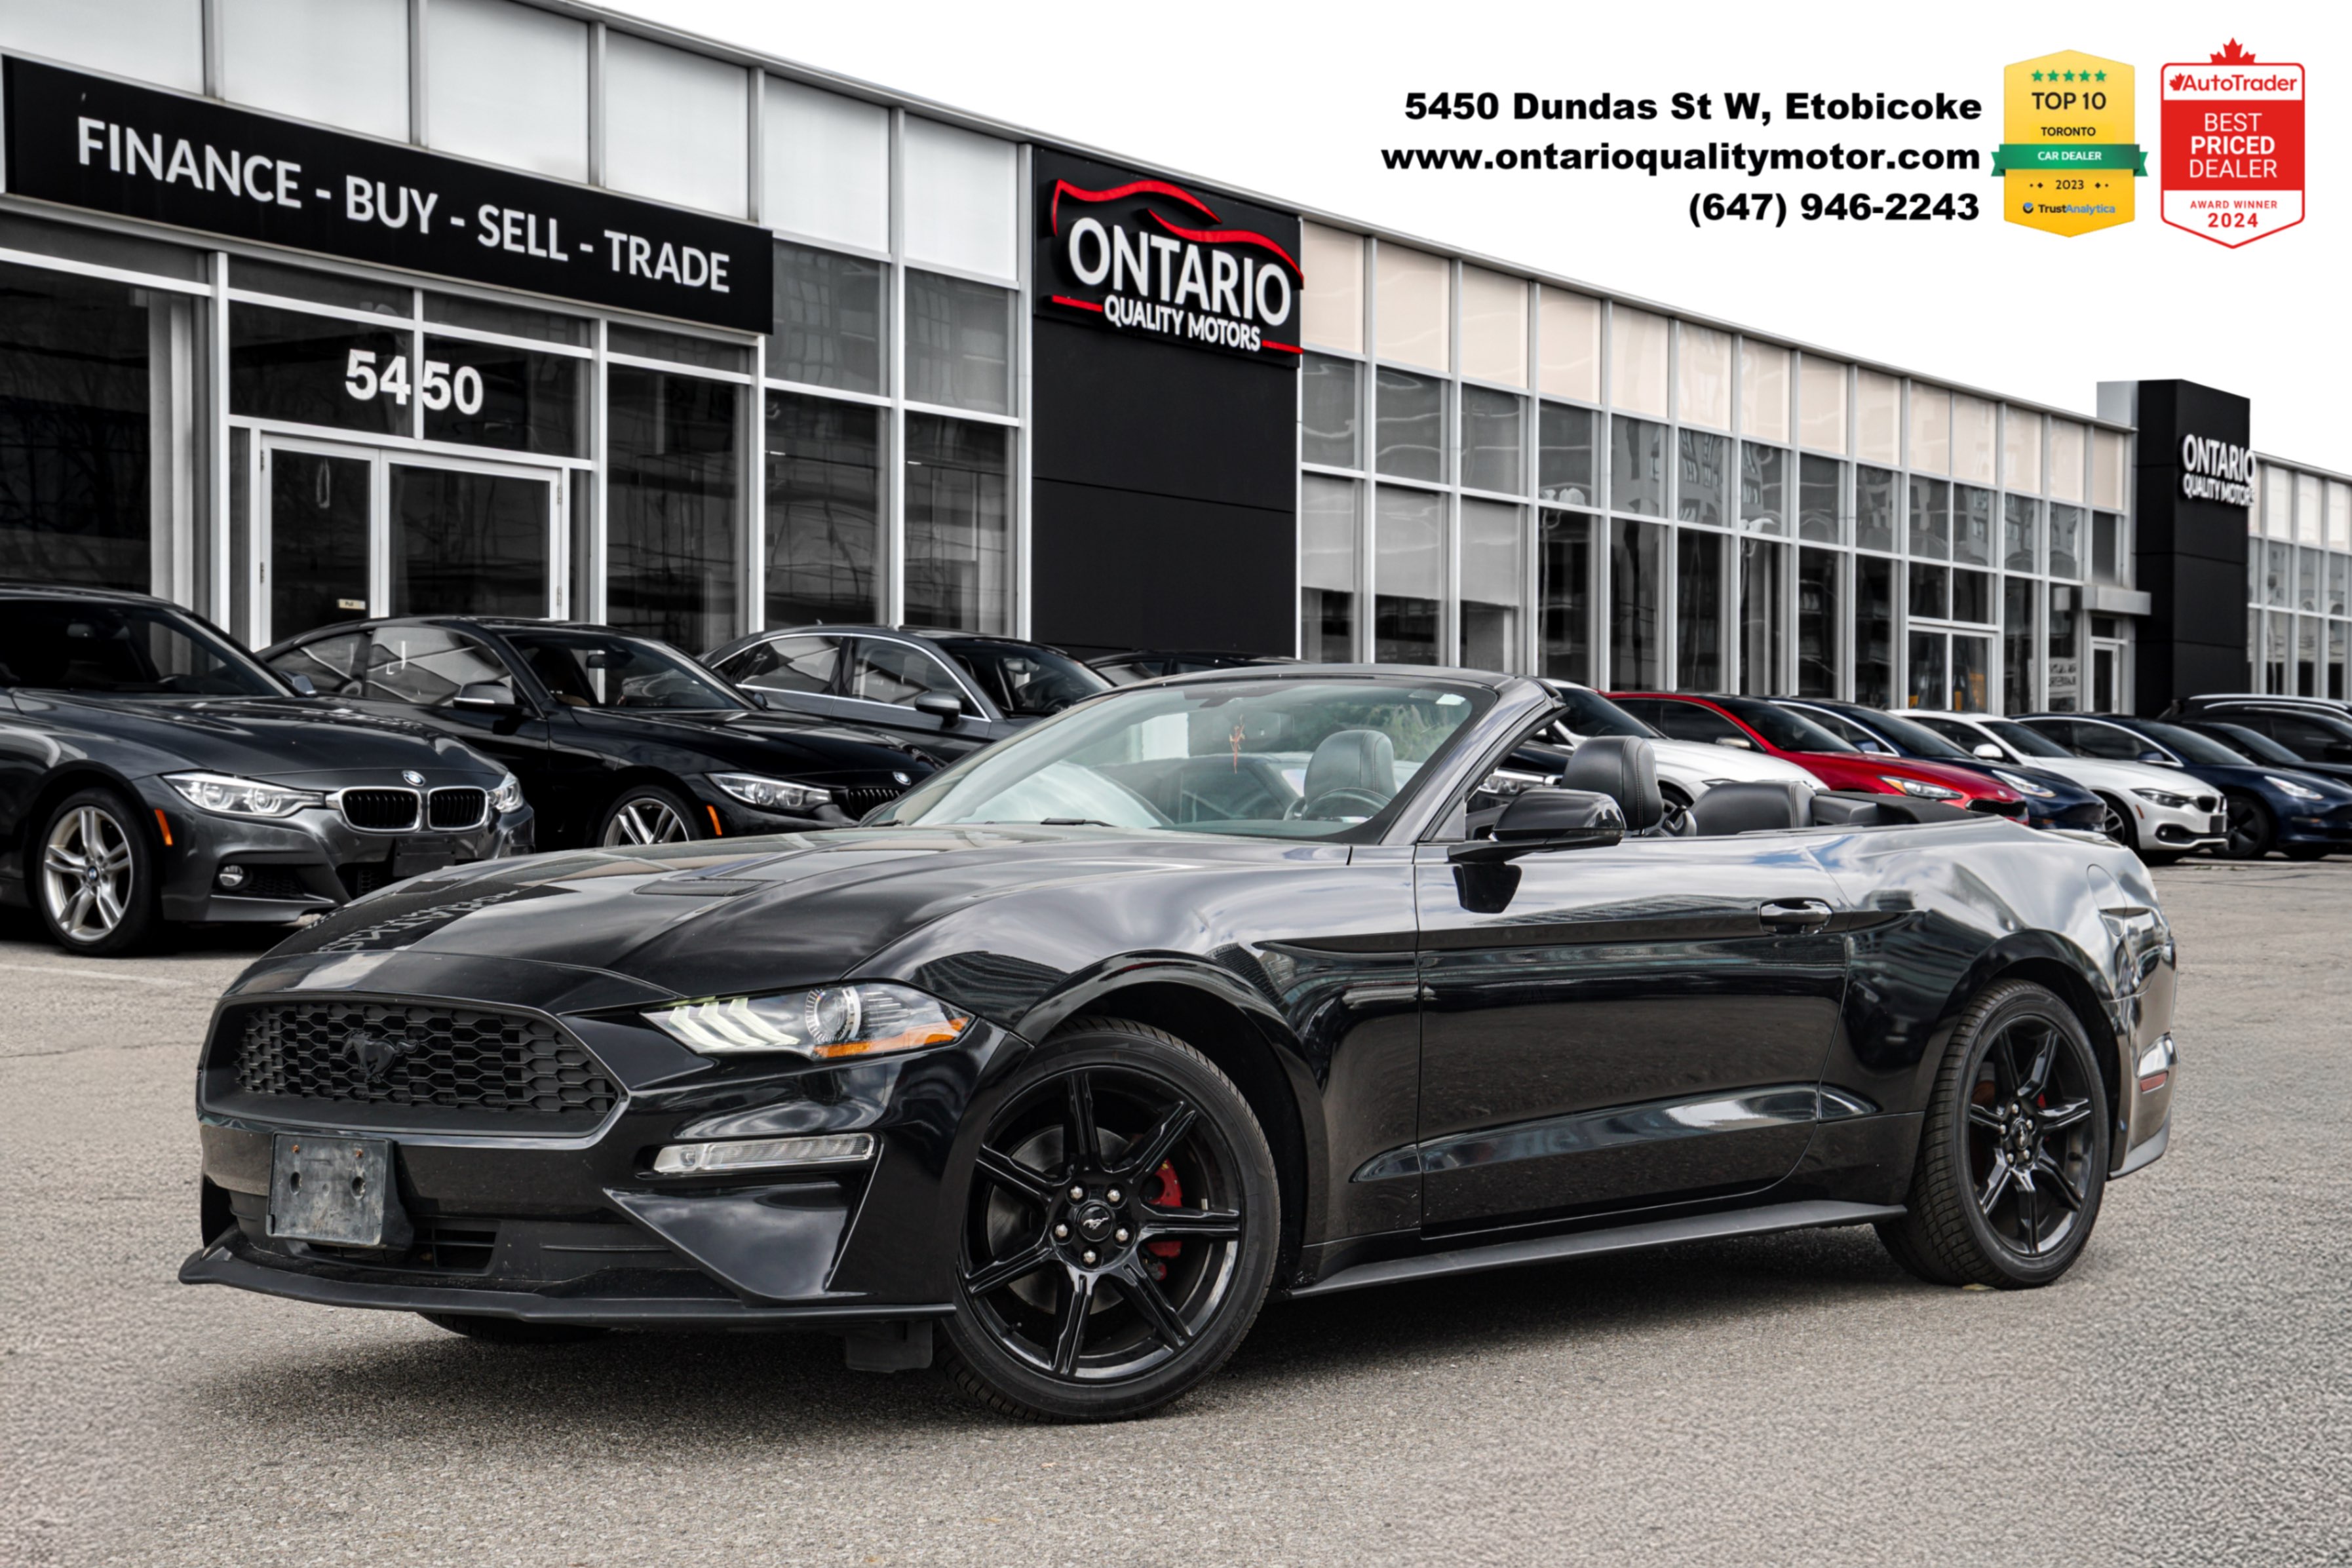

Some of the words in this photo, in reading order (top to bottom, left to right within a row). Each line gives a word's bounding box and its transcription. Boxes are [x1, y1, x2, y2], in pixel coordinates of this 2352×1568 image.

[79, 117, 301, 208] FINANCE
[346, 175, 438, 234] BUY
[478, 204, 568, 261] SELL
[604, 230, 729, 293] TRADE
[1069, 217, 1291, 326] ONTARIO
[1104, 294, 1184, 335] QUALITY
[1188, 312, 1261, 351] MOTORS
[2183, 434, 2256, 484] ONTARIO
[2183, 473, 2220, 500] QUALITY
